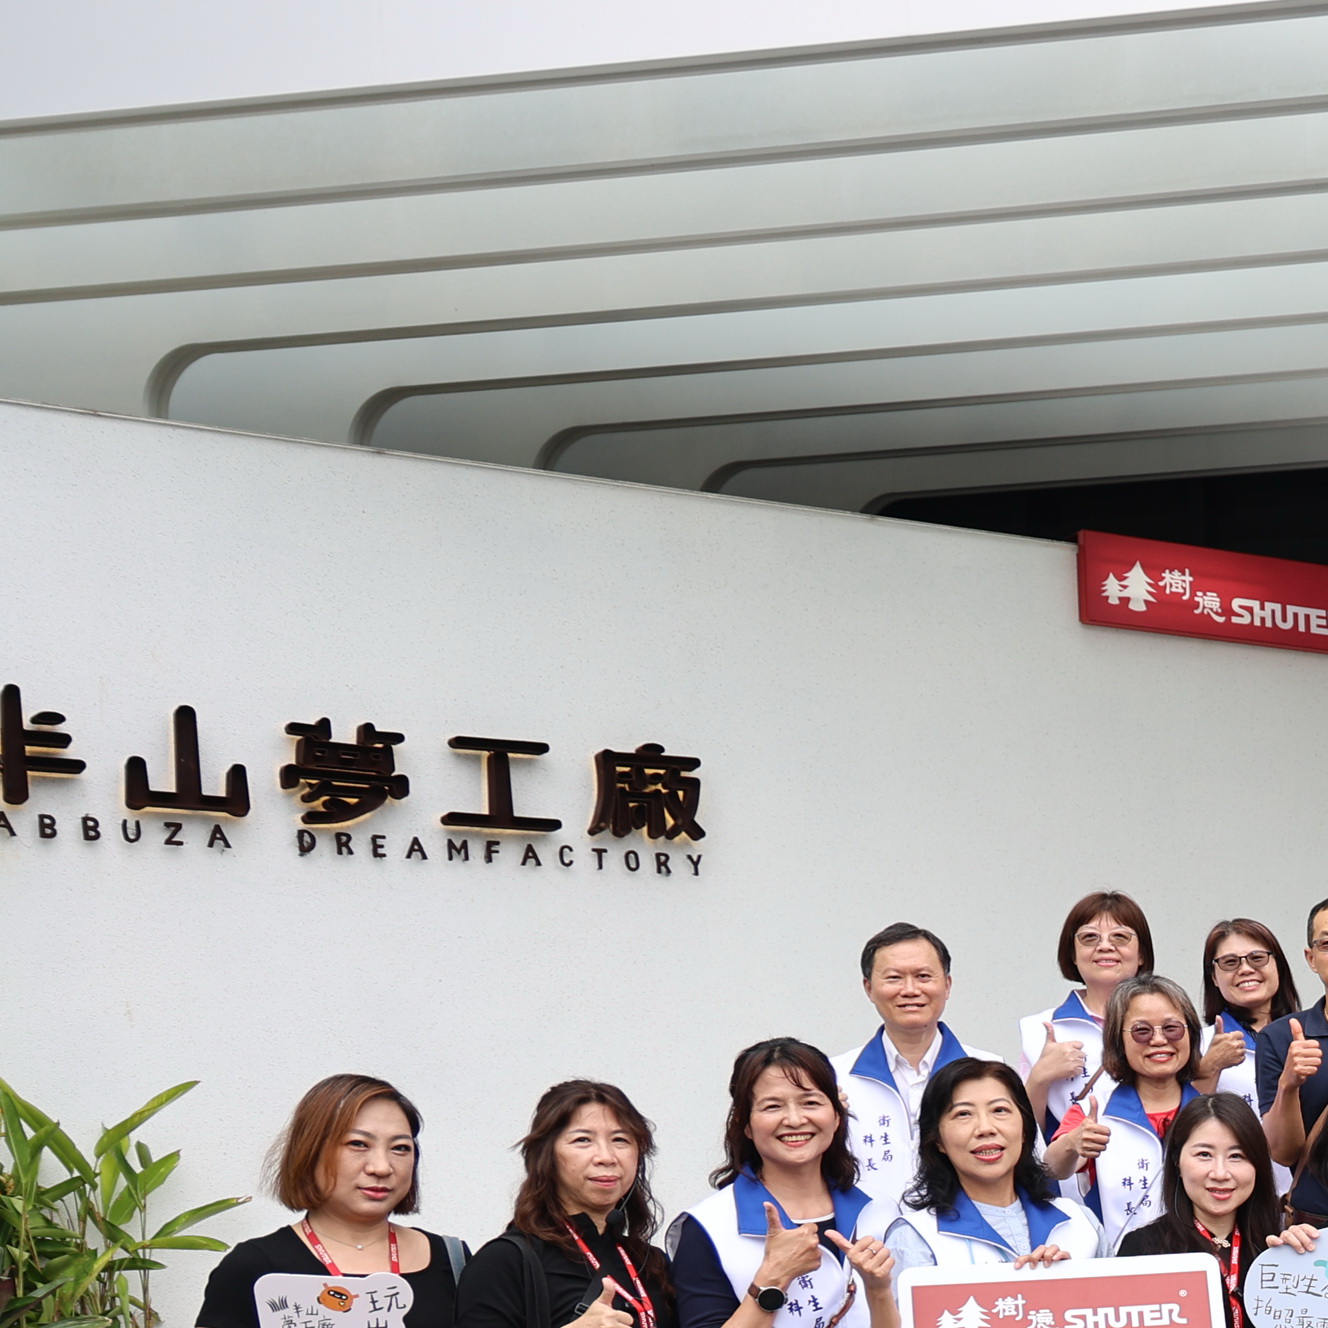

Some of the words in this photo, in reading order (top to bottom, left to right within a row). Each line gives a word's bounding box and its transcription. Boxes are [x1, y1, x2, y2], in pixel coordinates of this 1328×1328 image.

[297, 828, 704, 876] DREAMFACTORY
[863, 1134, 878, 1172] 科長
[878, 1114, 894, 1163] 衛生局
[1121, 1176, 1138, 1216] 科長
[1137, 1158, 1152, 1208] 衛生局
[292, 1302, 318, 1318] 半山
